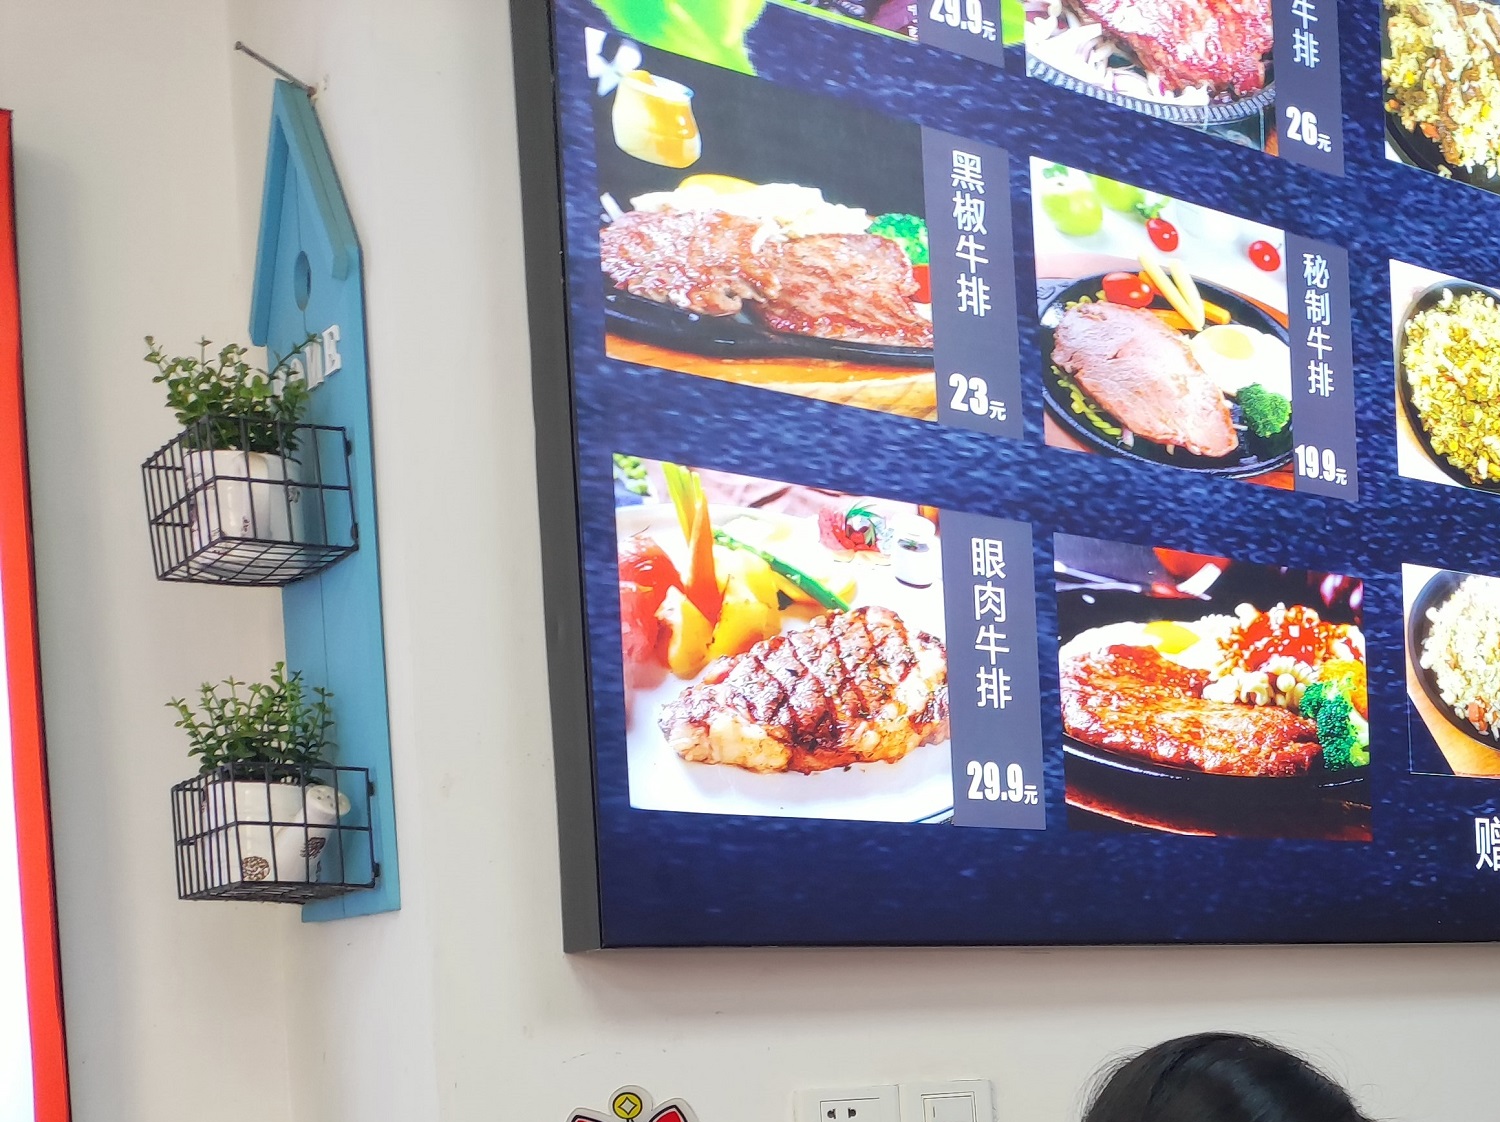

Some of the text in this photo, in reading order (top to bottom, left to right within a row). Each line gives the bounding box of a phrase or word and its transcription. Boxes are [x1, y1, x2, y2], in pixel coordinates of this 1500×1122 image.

[929, 0, 997, 41] 29.9元
[1286, 106, 1332, 153] 26元
[949, 148, 992, 317] 黑椒牛排
[1303, 252, 1336, 396] 秘制牛排
[948, 372, 1006, 422] 23元
[1295, 443, 1348, 487] 19.9元
[971, 537, 1013, 709] 眼肉牛排
[966, 760, 1038, 805] 29.9元
